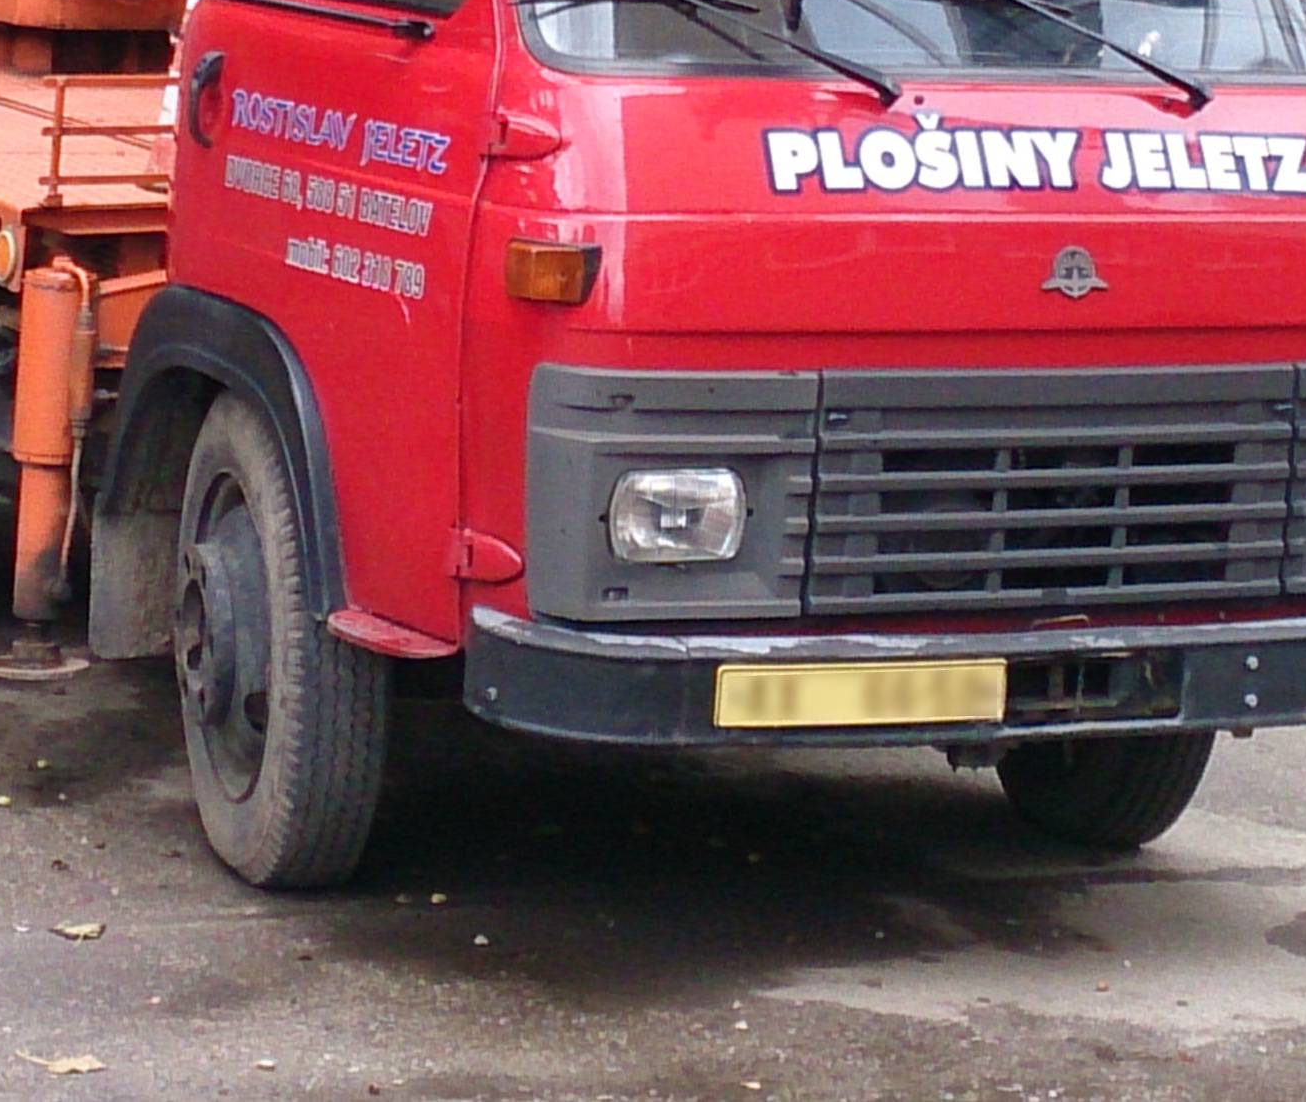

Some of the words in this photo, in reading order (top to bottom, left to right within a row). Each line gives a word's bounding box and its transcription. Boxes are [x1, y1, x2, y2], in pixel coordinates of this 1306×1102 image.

[231, 88, 358, 152] ROSTISLAV
[359, 119, 451, 174] JELETZ
[763, 110, 1083, 196] PLOŠINY
[358, 187, 435, 238] BATELOV
[330, 242, 362, 284] 602
[361, 250, 392, 292] 318
[393, 258, 427, 300] 789
